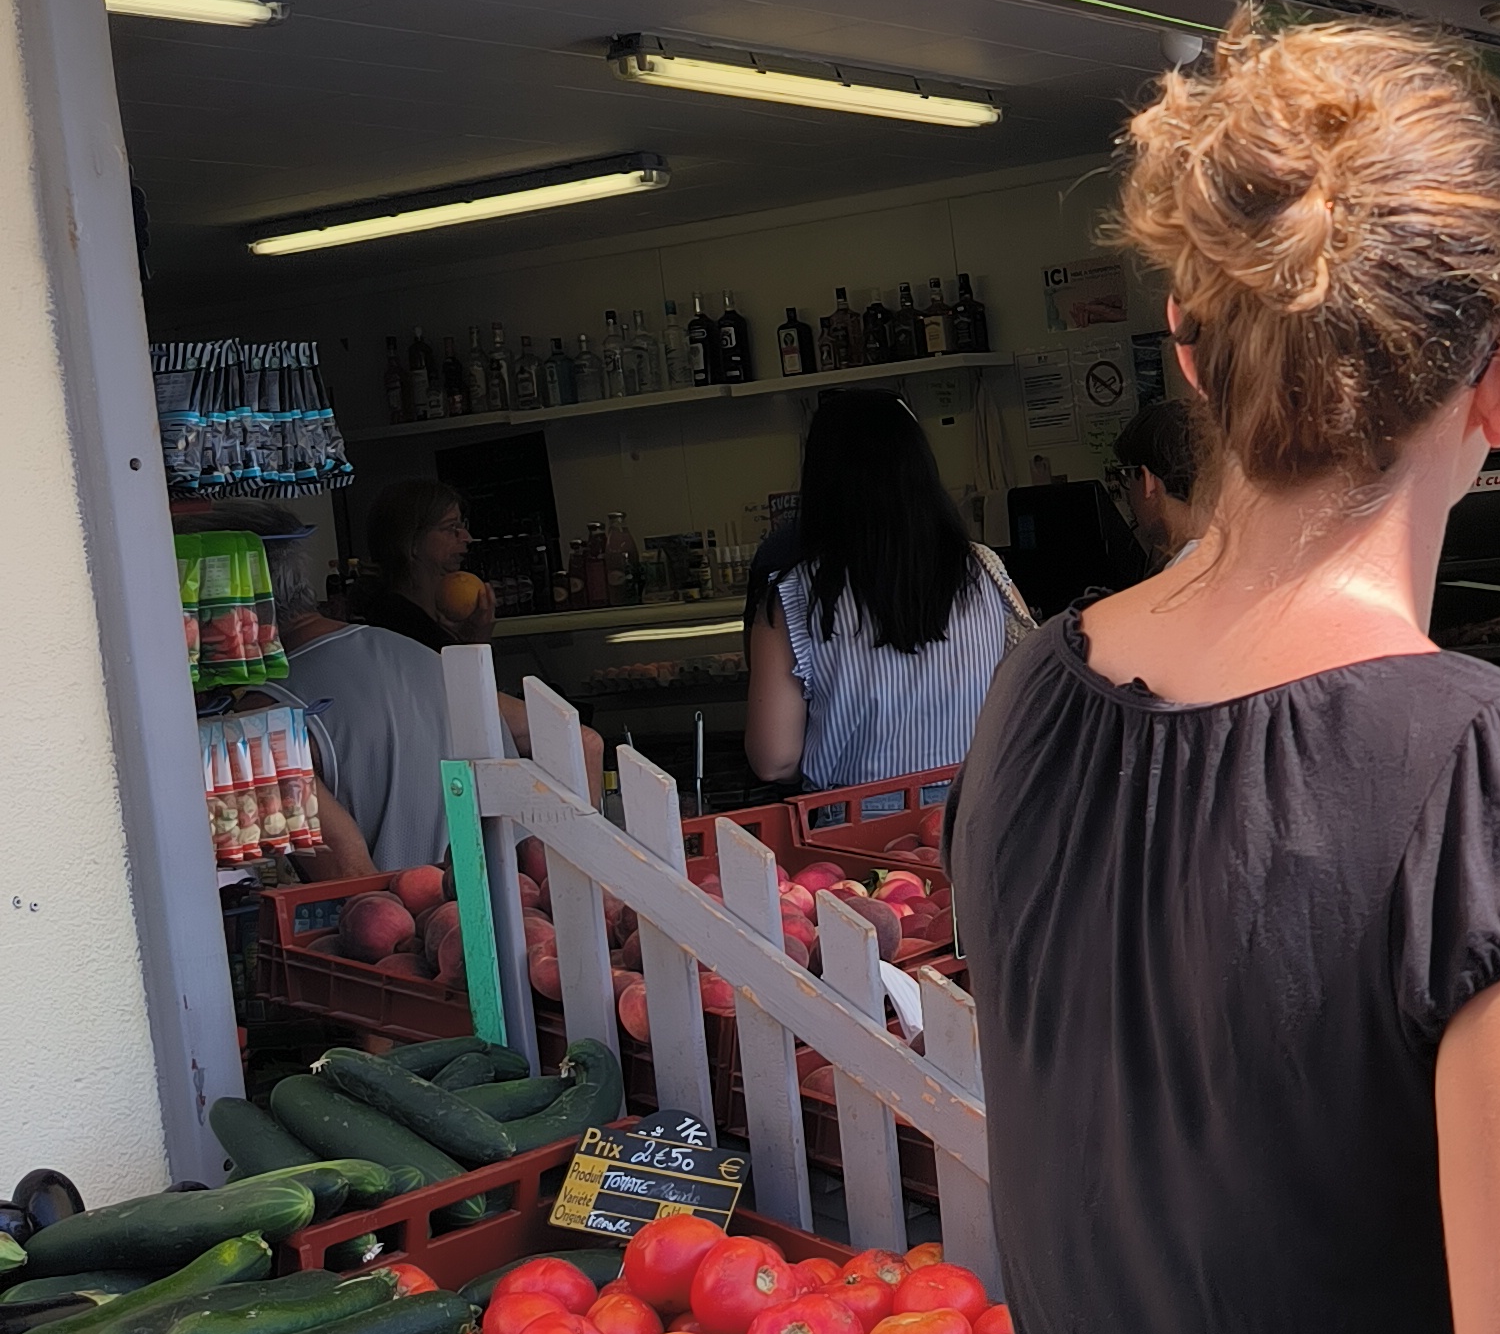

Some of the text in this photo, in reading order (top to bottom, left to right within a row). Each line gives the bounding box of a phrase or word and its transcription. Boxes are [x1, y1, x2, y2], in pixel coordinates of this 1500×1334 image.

[1044, 267, 1068, 286] ICI
[580, 1127, 623, 1159] Prix
[569, 1162, 603, 1185] Produit
[562, 1186, 593, 1208] Variété
[554, 1204, 586, 1227] Origine
